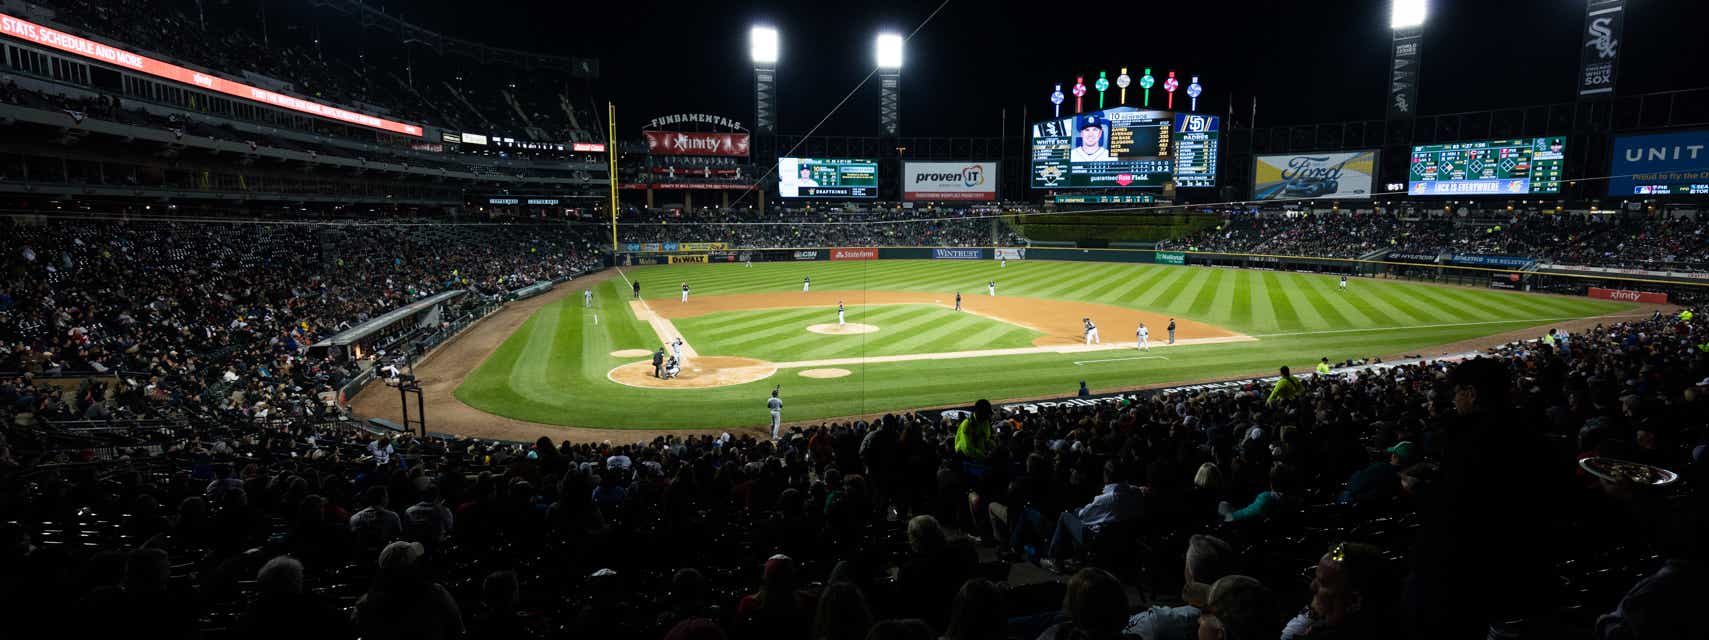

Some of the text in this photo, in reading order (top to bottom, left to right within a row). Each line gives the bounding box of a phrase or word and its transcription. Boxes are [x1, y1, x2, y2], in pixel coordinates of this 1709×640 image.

[3, 17, 143, 68] STATS, SCHEDULE AND MORE
[1584, 76, 1610, 86] SOX
[651, 114, 741, 130] FUNDAMENTALS
[674, 136, 720, 152] xfinity
[1625, 145, 1704, 162] UNIT
[1281, 157, 1346, 180] Ford
[915, 171, 979, 183] proven IT
[936, 249, 979, 257] WINTRUST
[1609, 289, 1641, 301] xfinity
